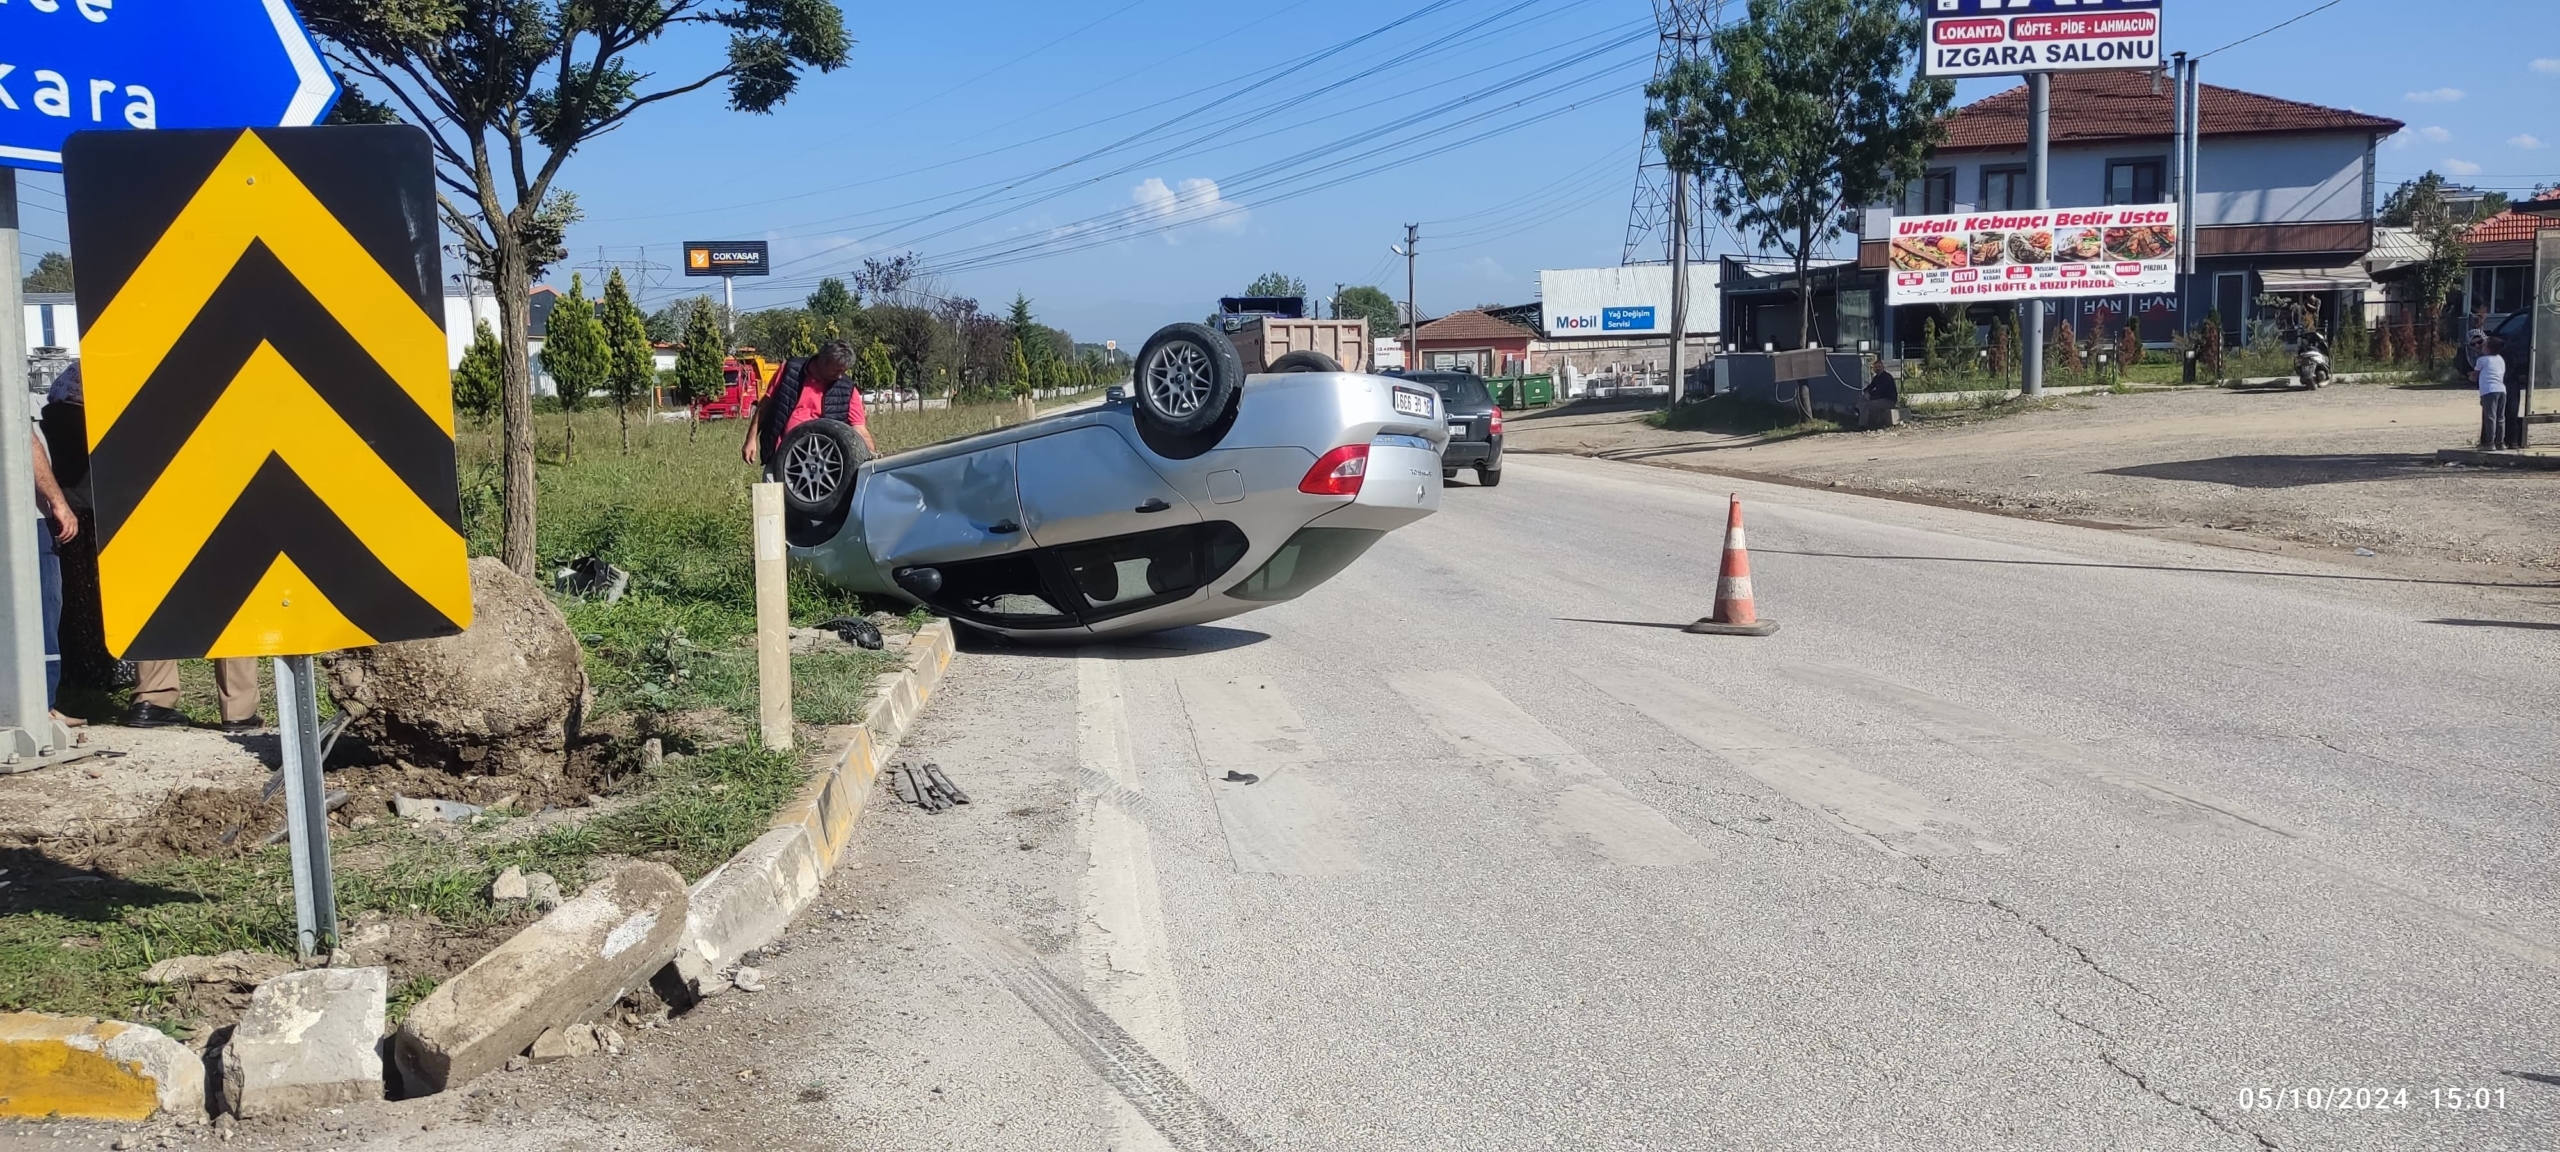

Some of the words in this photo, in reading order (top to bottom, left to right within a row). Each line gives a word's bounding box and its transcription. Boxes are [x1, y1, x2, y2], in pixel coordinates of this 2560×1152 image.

[1938, 24, 2003, 41] LOKANTA
[2016, 20, 2052, 37] KÖFTE
[2060, 18, 2086, 35] PİDE
[2094, 17, 2154, 34] LAHMACUN
[1937, 45, 2037, 68] IZGARA
[2045, 39, 2154, 63] SALONU
[1898, 217, 1957, 235] Urfalı
[1963, 214, 2049, 232] Kebapçı
[2054, 211, 2114, 227] Bedir
[2119, 209, 2169, 225] Usta
[2143, 263, 2168, 271] PİRZOLA
[1953, 269, 1976, 282] BEYTİ
[1950, 285, 1974, 295] KİLO
[1976, 283, 1992, 294] İŞİ
[1994, 282, 2027, 292] KÖFTE
[2039, 281, 2068, 290] KUZU
[2070, 279, 2115, 289] PİRZOLA
[1608, 310, 1621, 319] Yağ
[1622, 309, 1650, 319] Değişim
[1556, 315, 1597, 329] Mobil
[1607, 319, 1630, 328] Servisi
